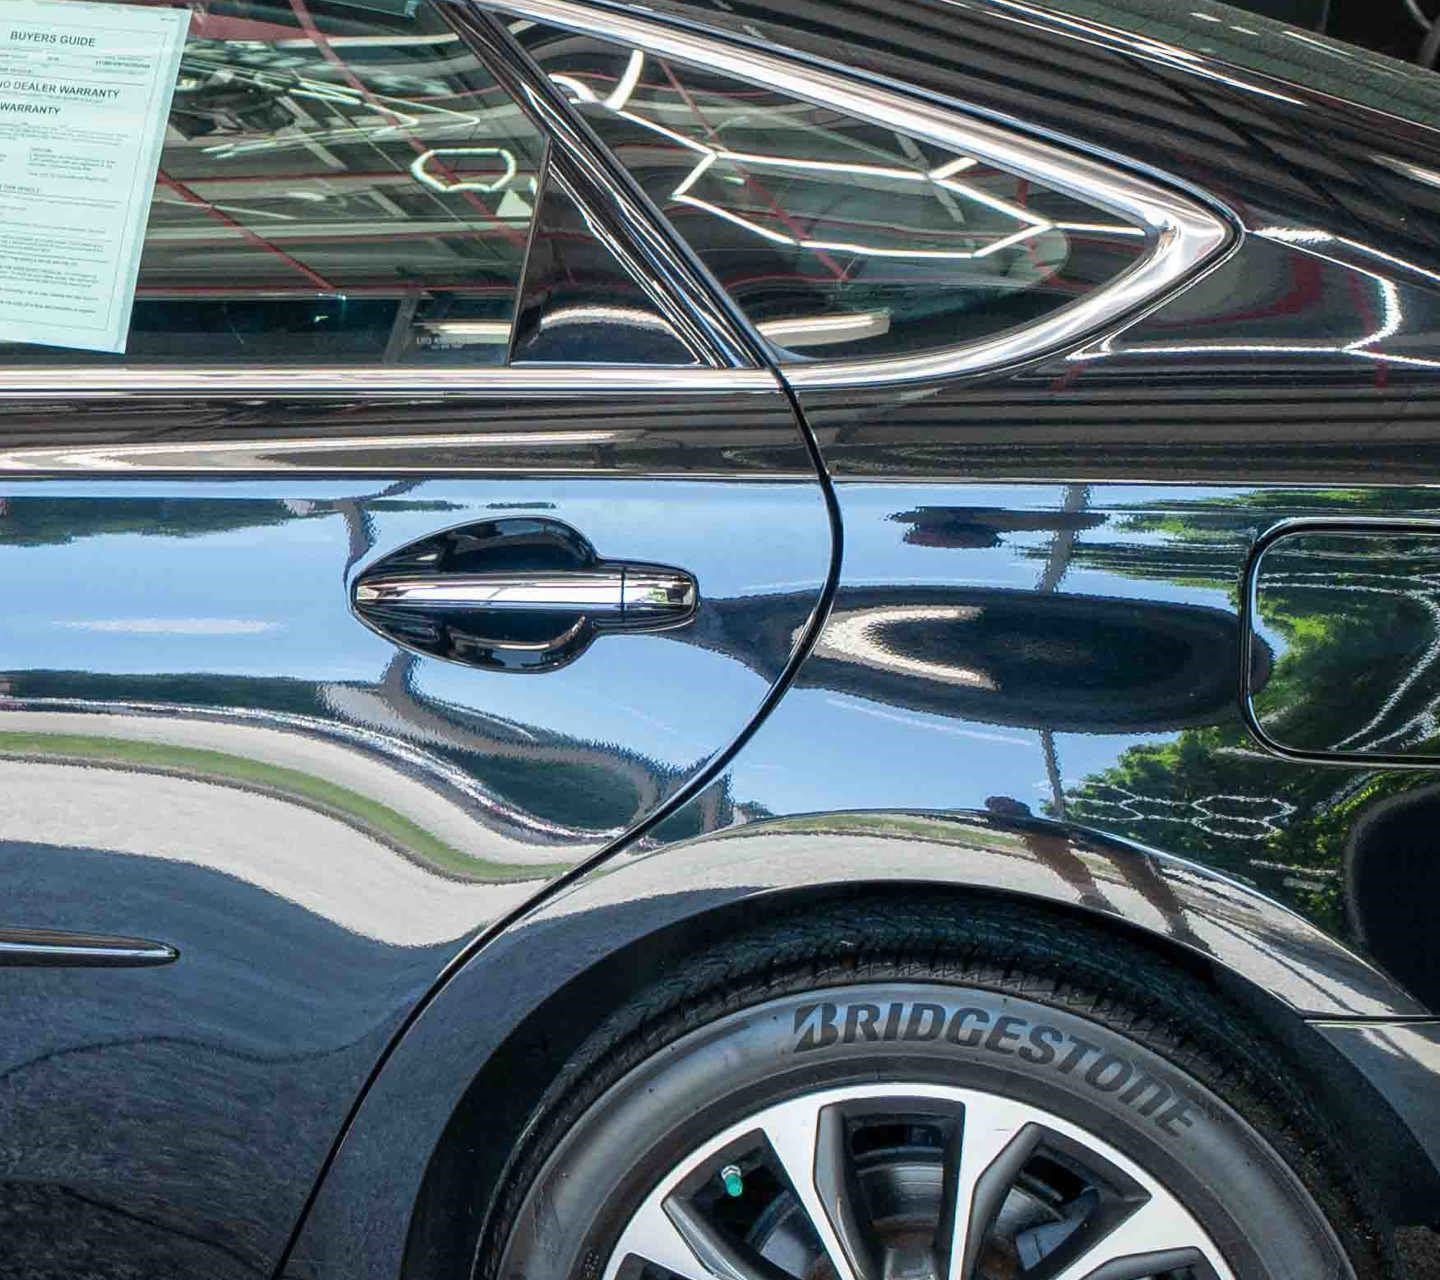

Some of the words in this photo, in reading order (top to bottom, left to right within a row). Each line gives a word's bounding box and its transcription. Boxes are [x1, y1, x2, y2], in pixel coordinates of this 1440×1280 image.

[10, 30, 57, 45] BUYERS
[59, 34, 97, 48] GUIDE
[13, 80, 58, 94] DEALER
[59, 84, 120, 99] WARRANTY
[0, 100, 61, 116] WARRANTY
[793, 1001, 1197, 1137] BRIDGESTONE
